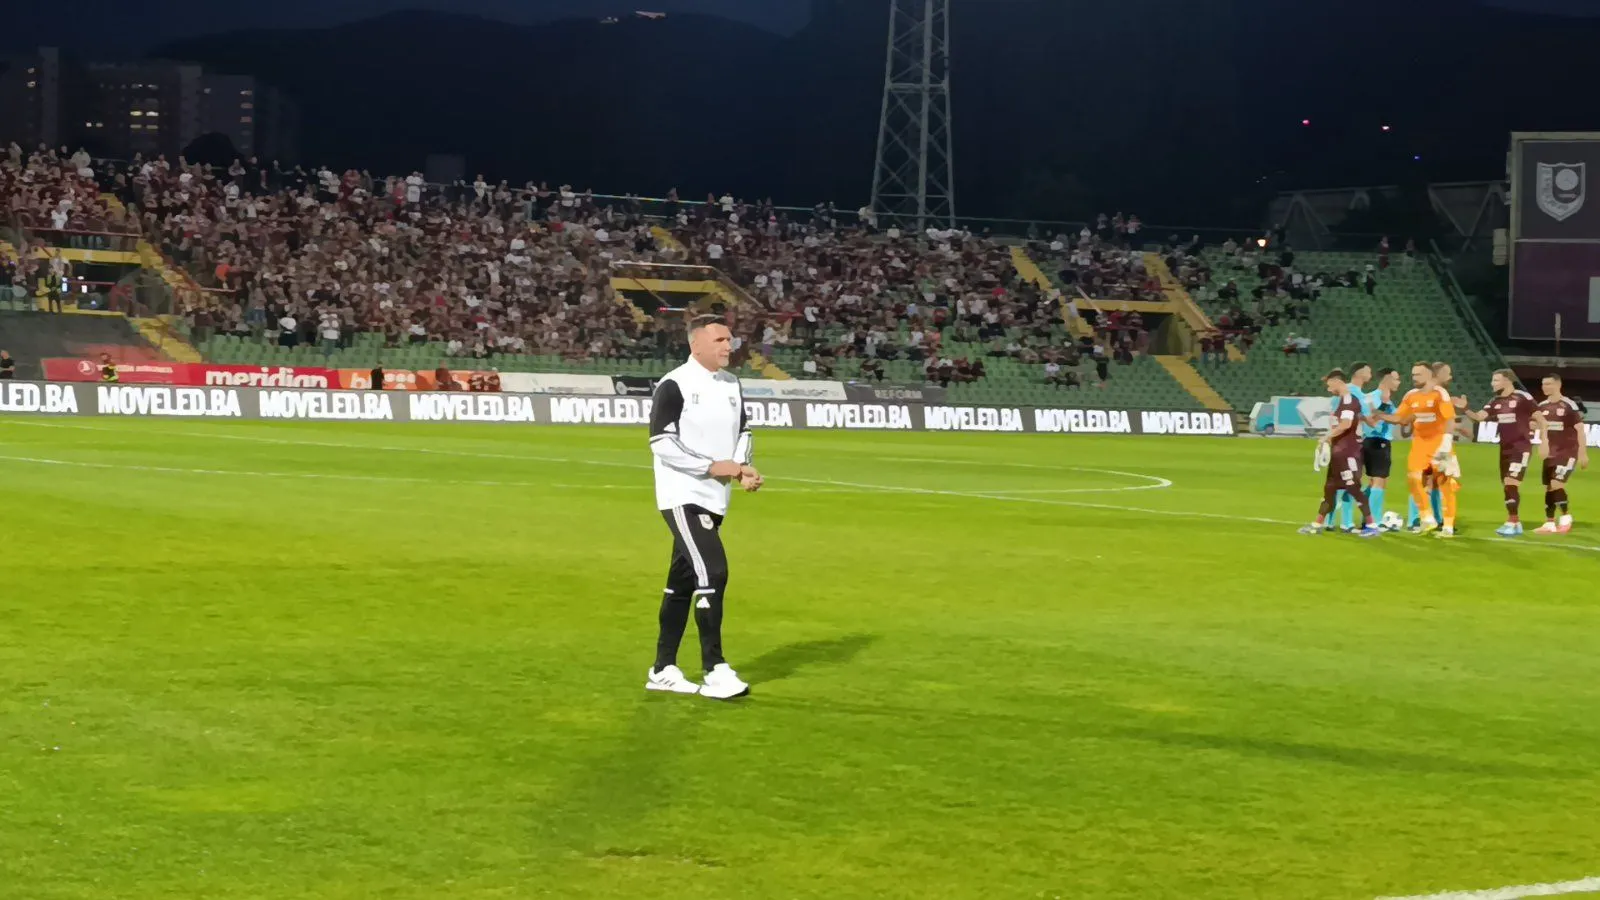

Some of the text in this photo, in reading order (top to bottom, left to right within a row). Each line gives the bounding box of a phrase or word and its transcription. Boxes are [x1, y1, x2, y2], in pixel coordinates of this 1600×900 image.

[205, 366, 328, 388] meridian
[97, 386, 242, 416] MOVELED.BA
[259, 390, 394, 420] MOVELED.BA
[874, 389, 923, 399] REFORM
[409, 394, 536, 422] MOVELED.BA
[806, 403, 913, 429] MOVELED.BA
[924, 406, 1024, 431] MOVELED.BA
[1034, 409, 1132, 432] MOVELED.BA
[1141, 411, 1234, 434] MOVELED.BA
